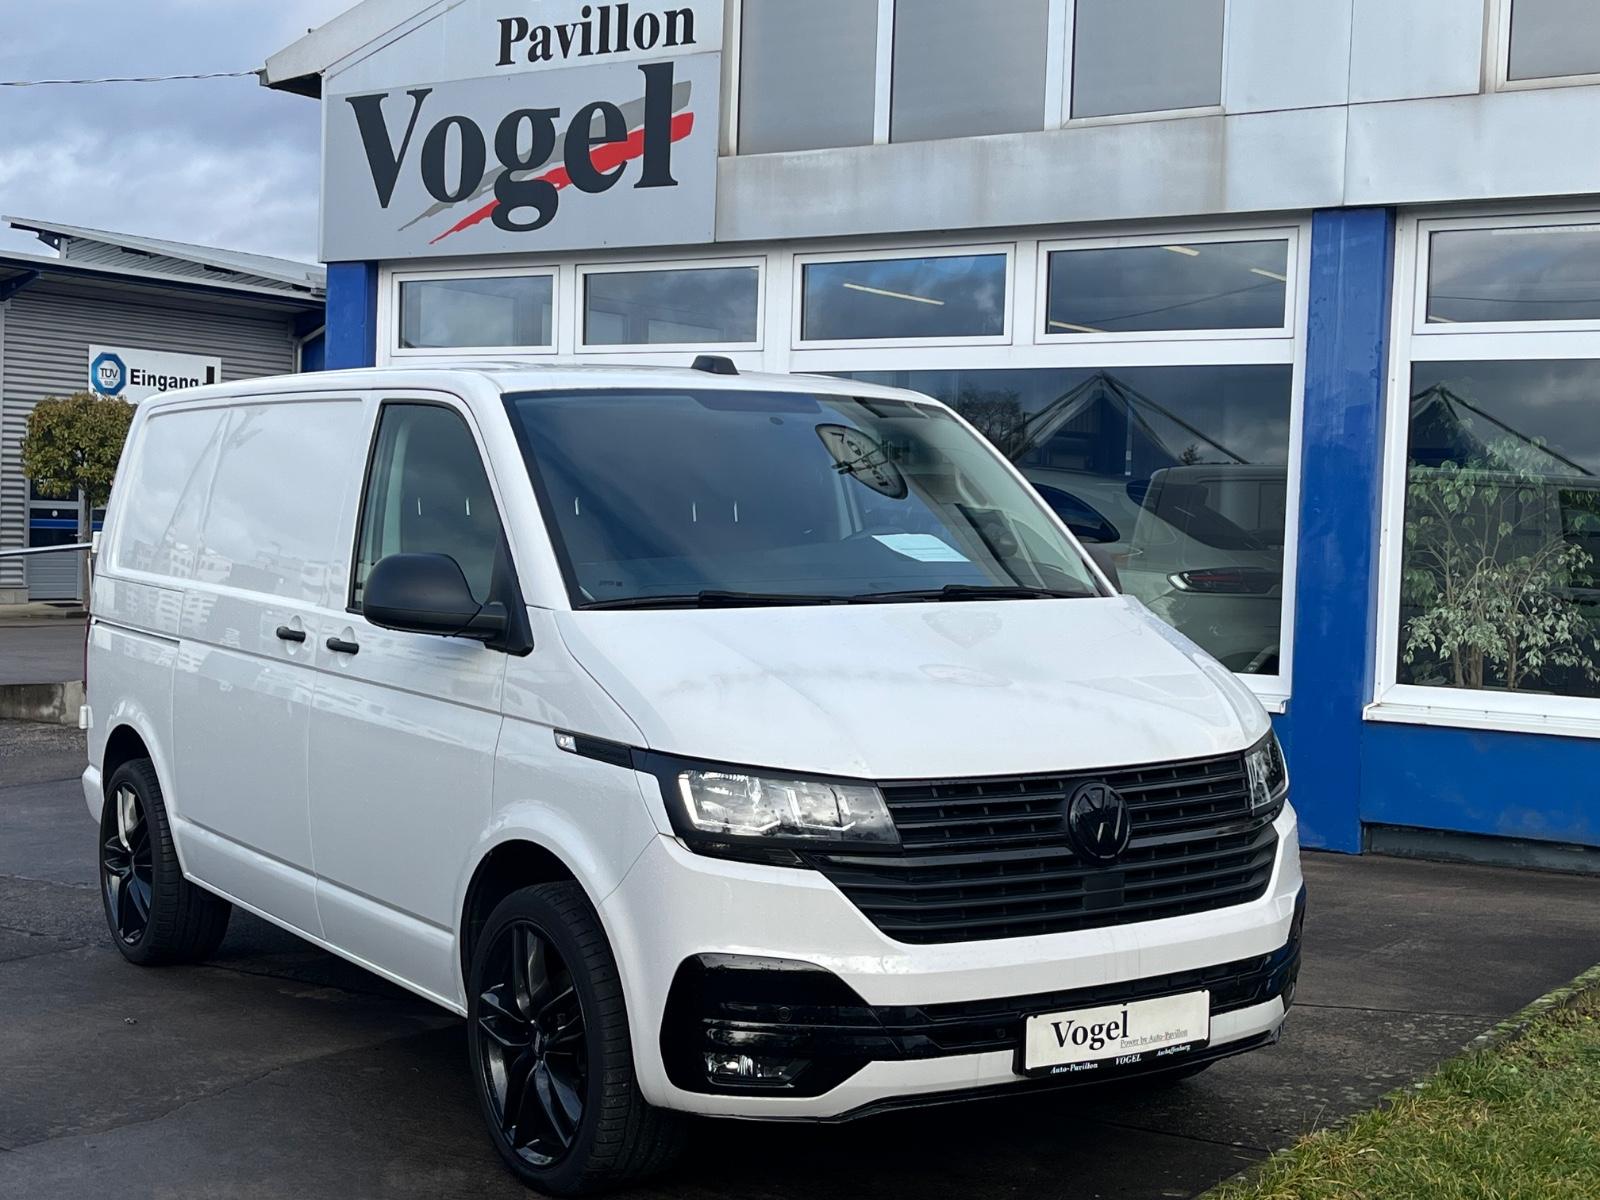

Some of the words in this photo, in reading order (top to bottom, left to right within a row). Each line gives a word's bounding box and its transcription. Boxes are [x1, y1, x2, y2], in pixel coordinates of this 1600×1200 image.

[495, 3, 697, 67] Pavillon
[345, 61, 679, 232] Vogel
[1051, 1010, 1129, 1050] Vogel
[1050, 1062, 1099, 1074] Auto-Pavillon
[1115, 1053, 1142, 1065] VOGEL
